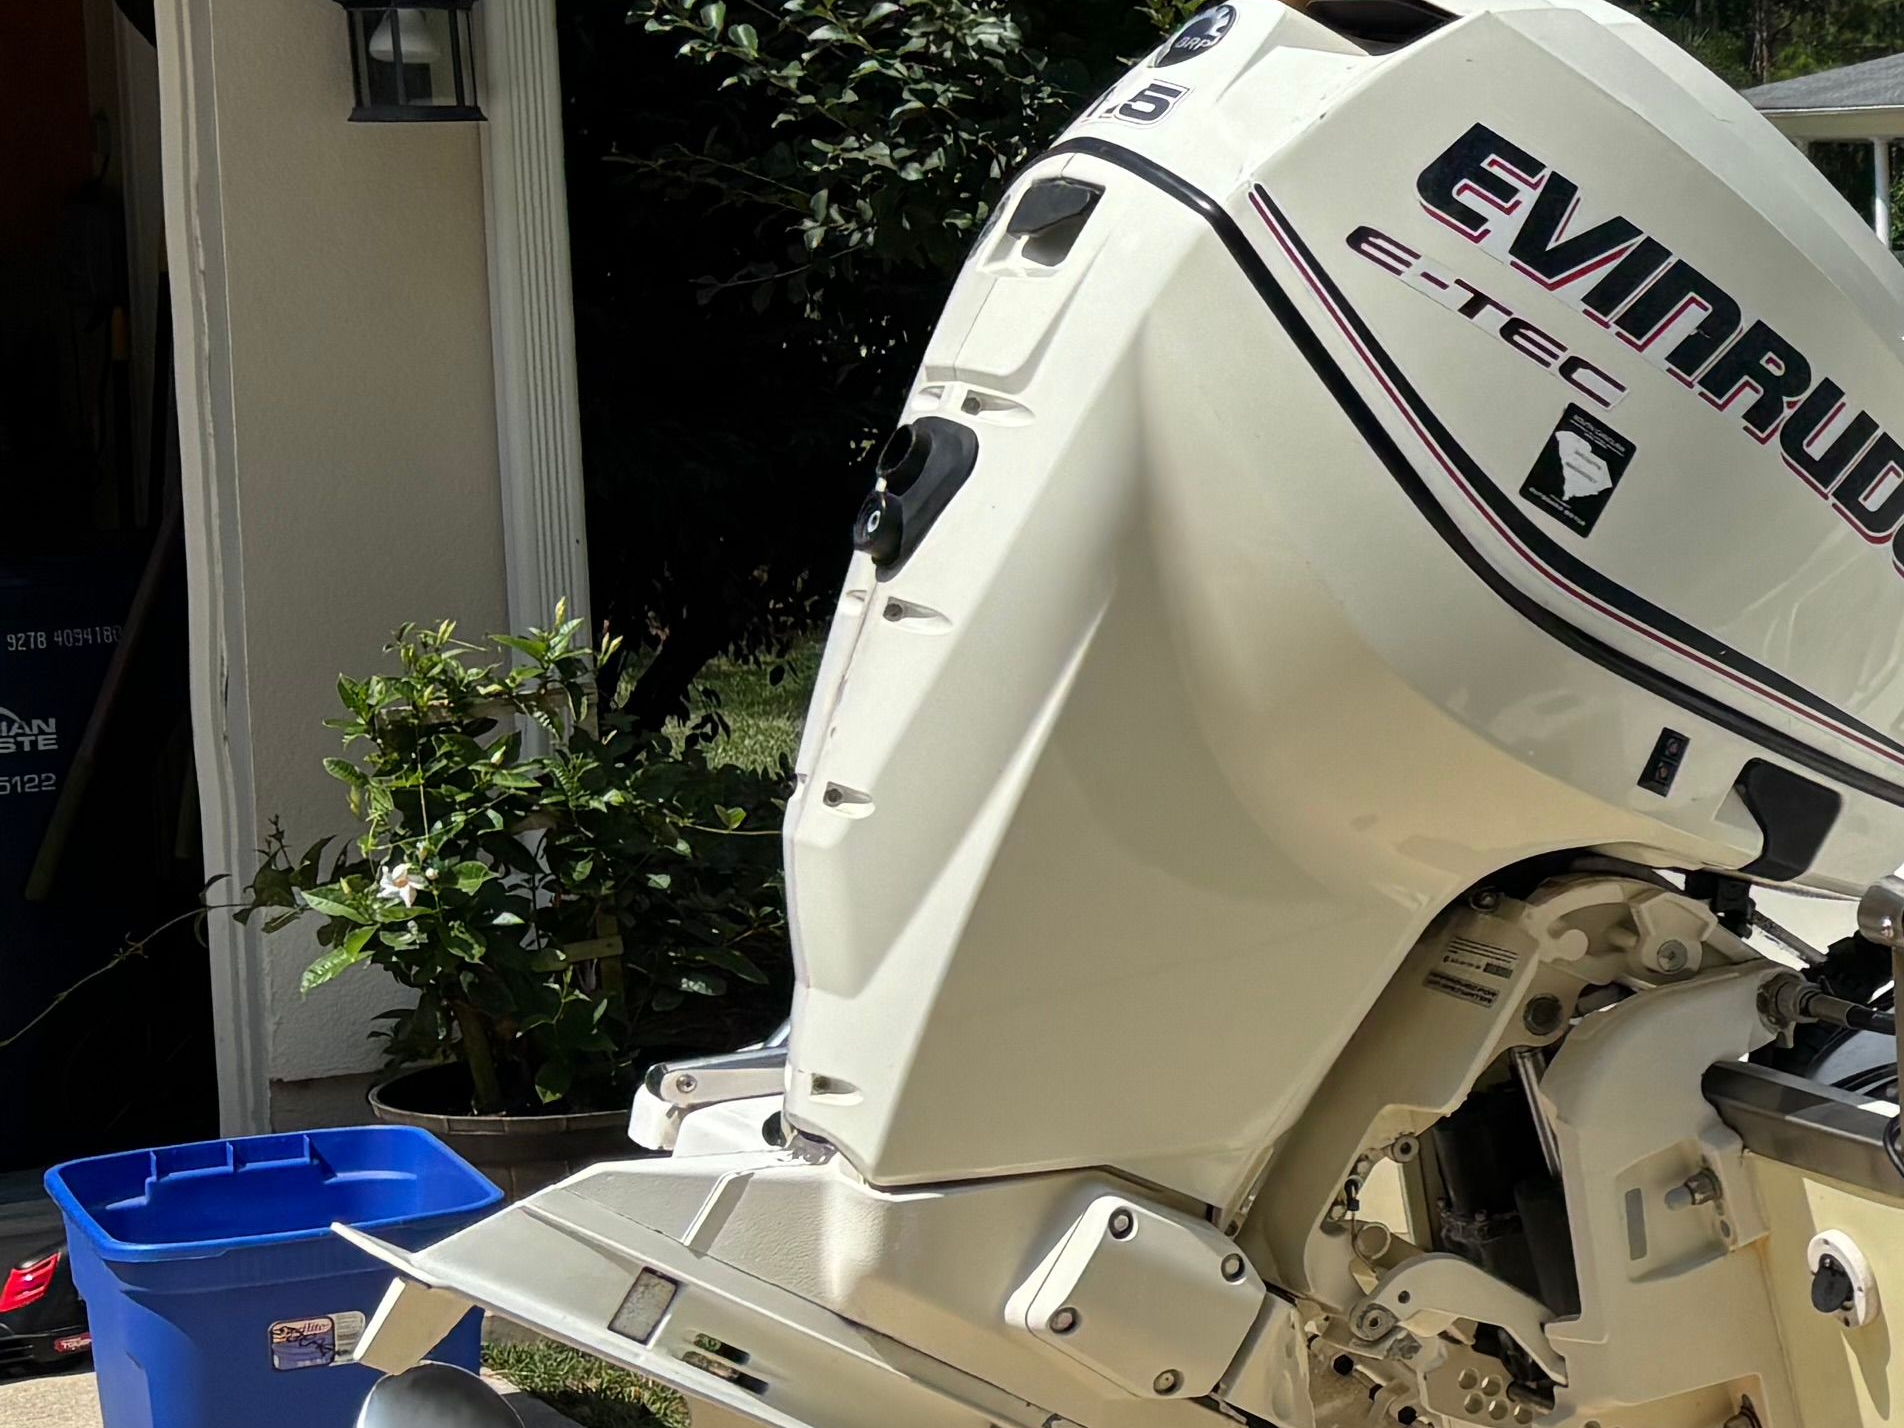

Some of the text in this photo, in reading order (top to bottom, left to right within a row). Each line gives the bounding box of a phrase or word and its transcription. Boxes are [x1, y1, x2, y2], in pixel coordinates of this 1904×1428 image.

[1174, 36, 1209, 51] BRP
[1345, 225, 1628, 409] E-TEC
[7, 631, 47, 651] 9278
